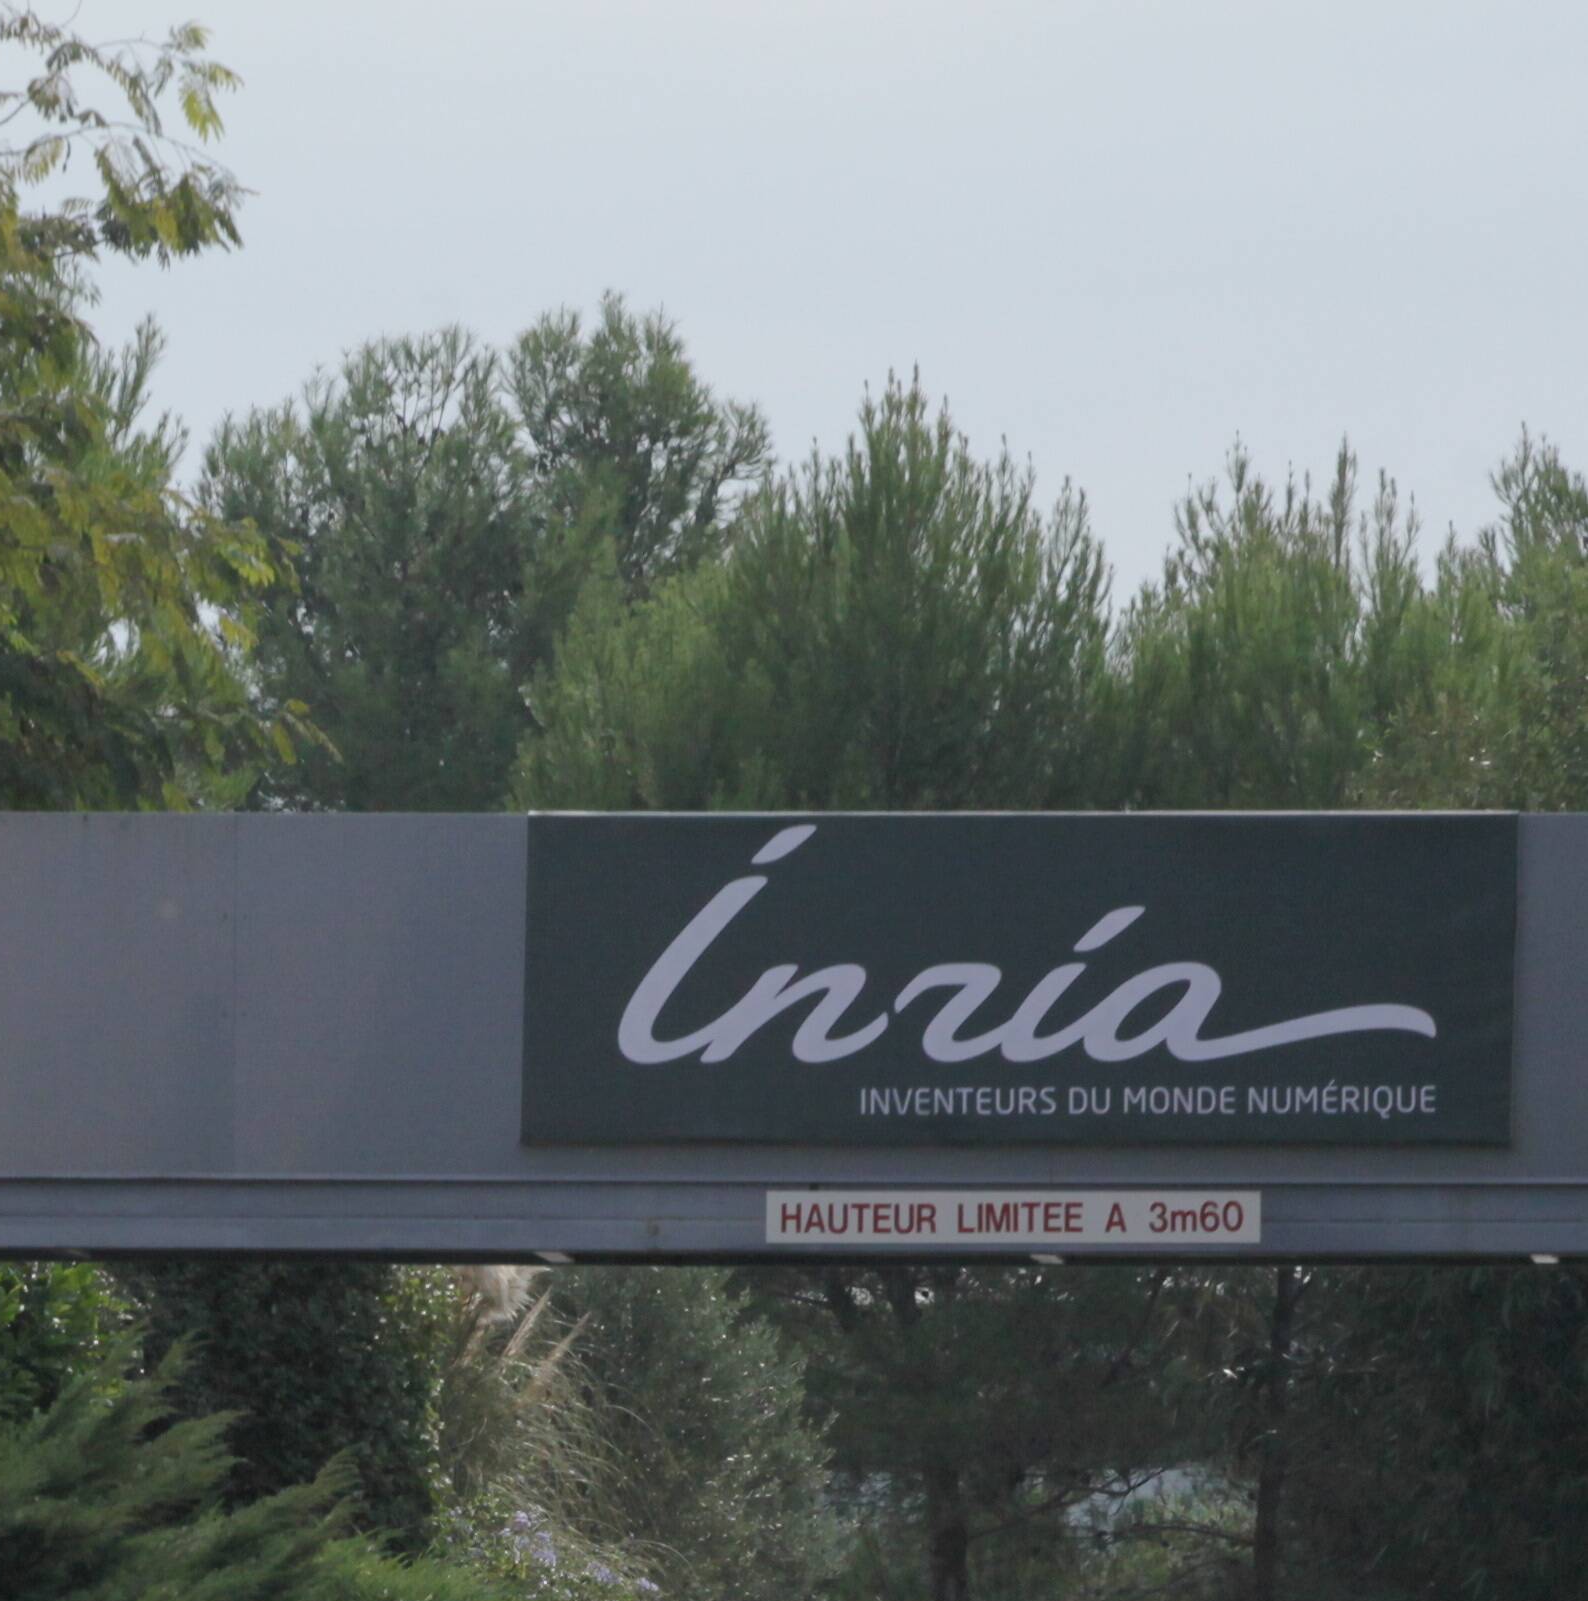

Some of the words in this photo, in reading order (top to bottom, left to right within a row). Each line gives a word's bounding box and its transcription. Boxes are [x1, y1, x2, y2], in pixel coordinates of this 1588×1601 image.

[860, 1086, 1057, 1115] INVENTEURS
[1068, 1086, 1111, 1115] DU
[1123, 1085, 1236, 1115] MONDE
[1247, 1079, 1436, 1119] NUMÉRIQUE
[781, 1202, 936, 1234] HAUTEUR
[957, 1202, 1084, 1233] LIMITEE
[1105, 1203, 1126, 1232] A
[1149, 1201, 1244, 1232] 3m60
